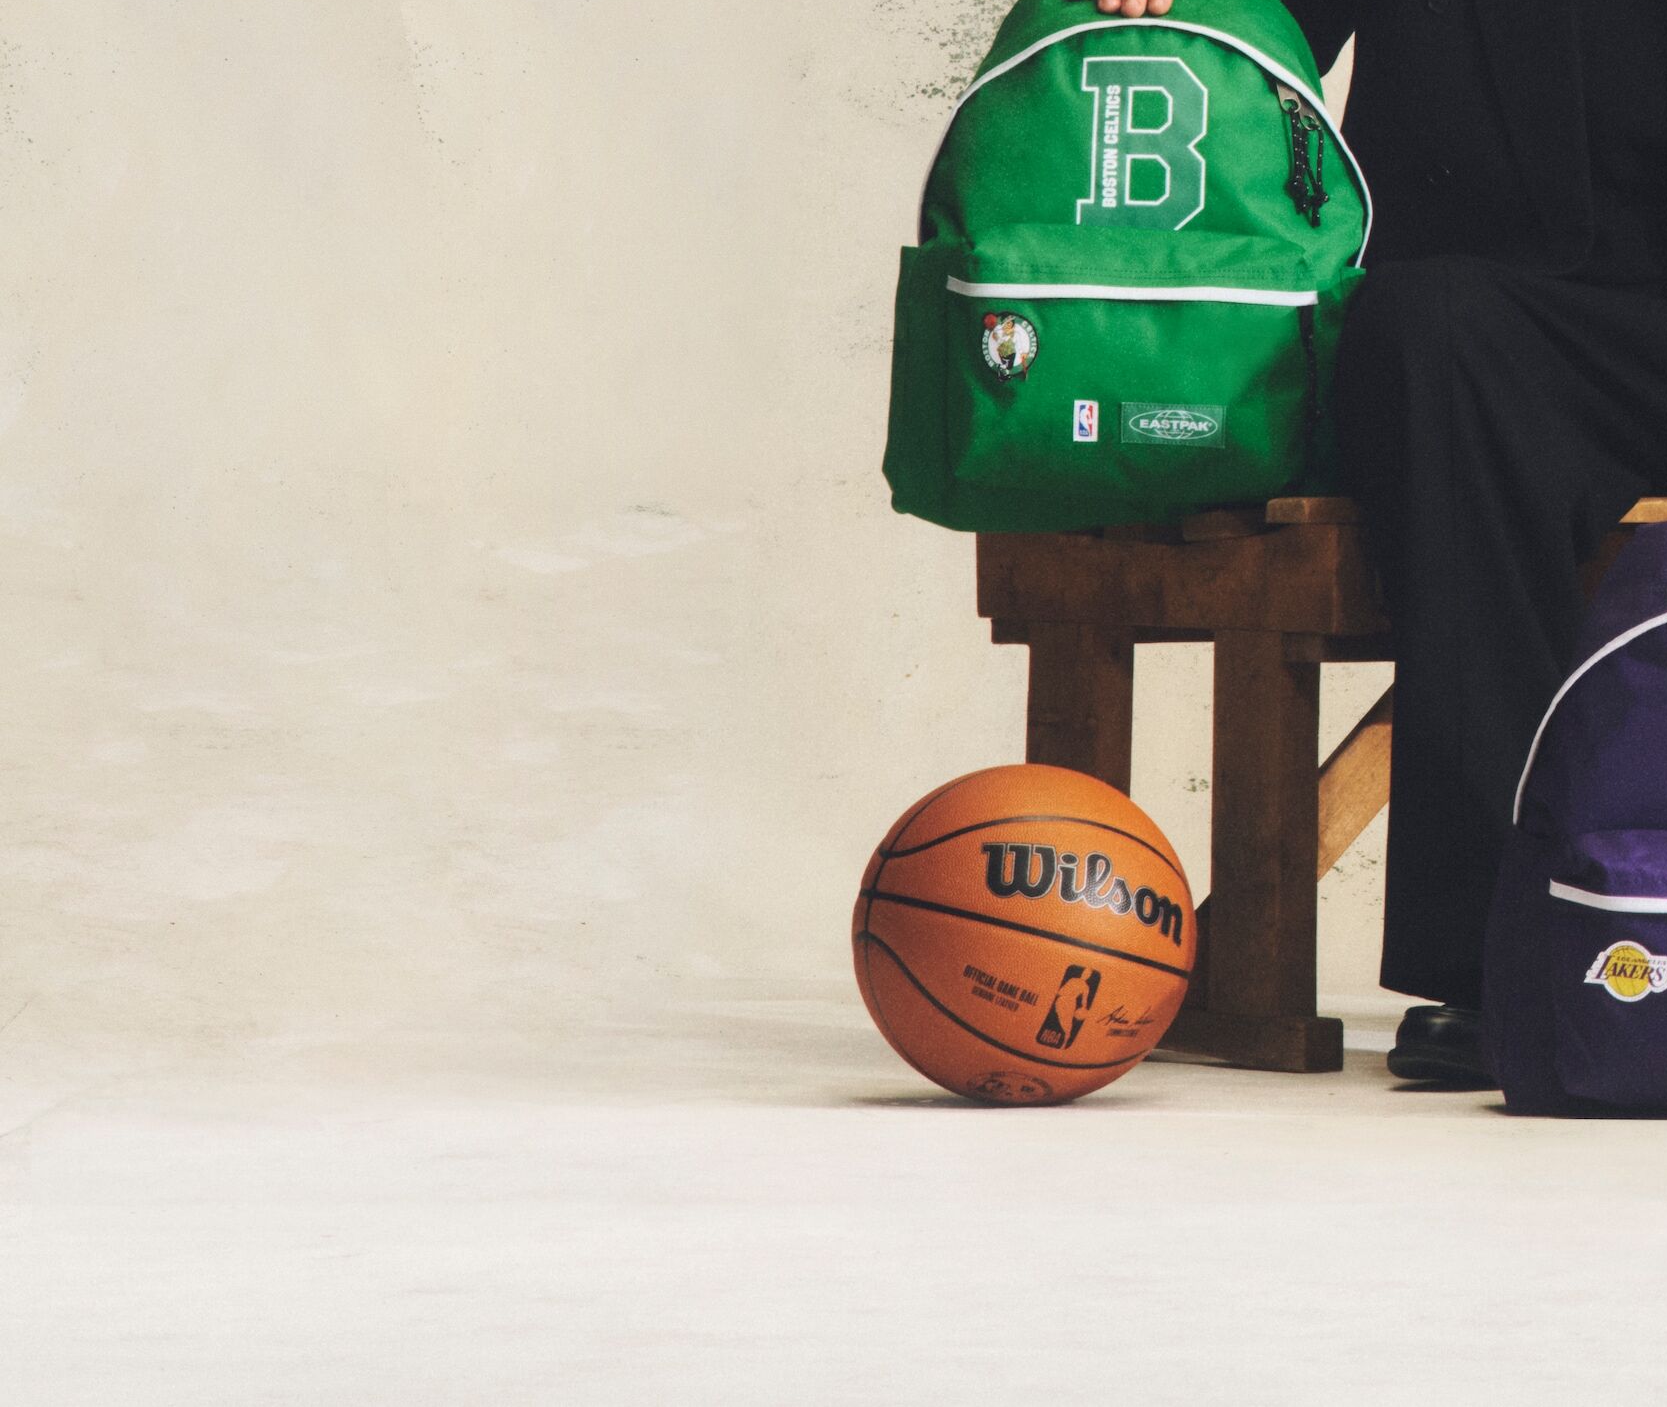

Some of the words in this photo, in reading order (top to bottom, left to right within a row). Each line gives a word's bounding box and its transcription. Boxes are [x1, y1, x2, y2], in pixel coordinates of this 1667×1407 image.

[1103, 84, 1121, 144] CELTICS
[1076, 55, 1209, 232] B
[1101, 148, 1119, 208] BOSTON
[1139, 419, 1209, 432] EASTPAK
[980, 841, 1184, 948] Wilson
[1595, 955, 1666, 988] LAKERS
[1019, 988, 1039, 1006] BALL
[1041, 1028, 1062, 1044] NBA
